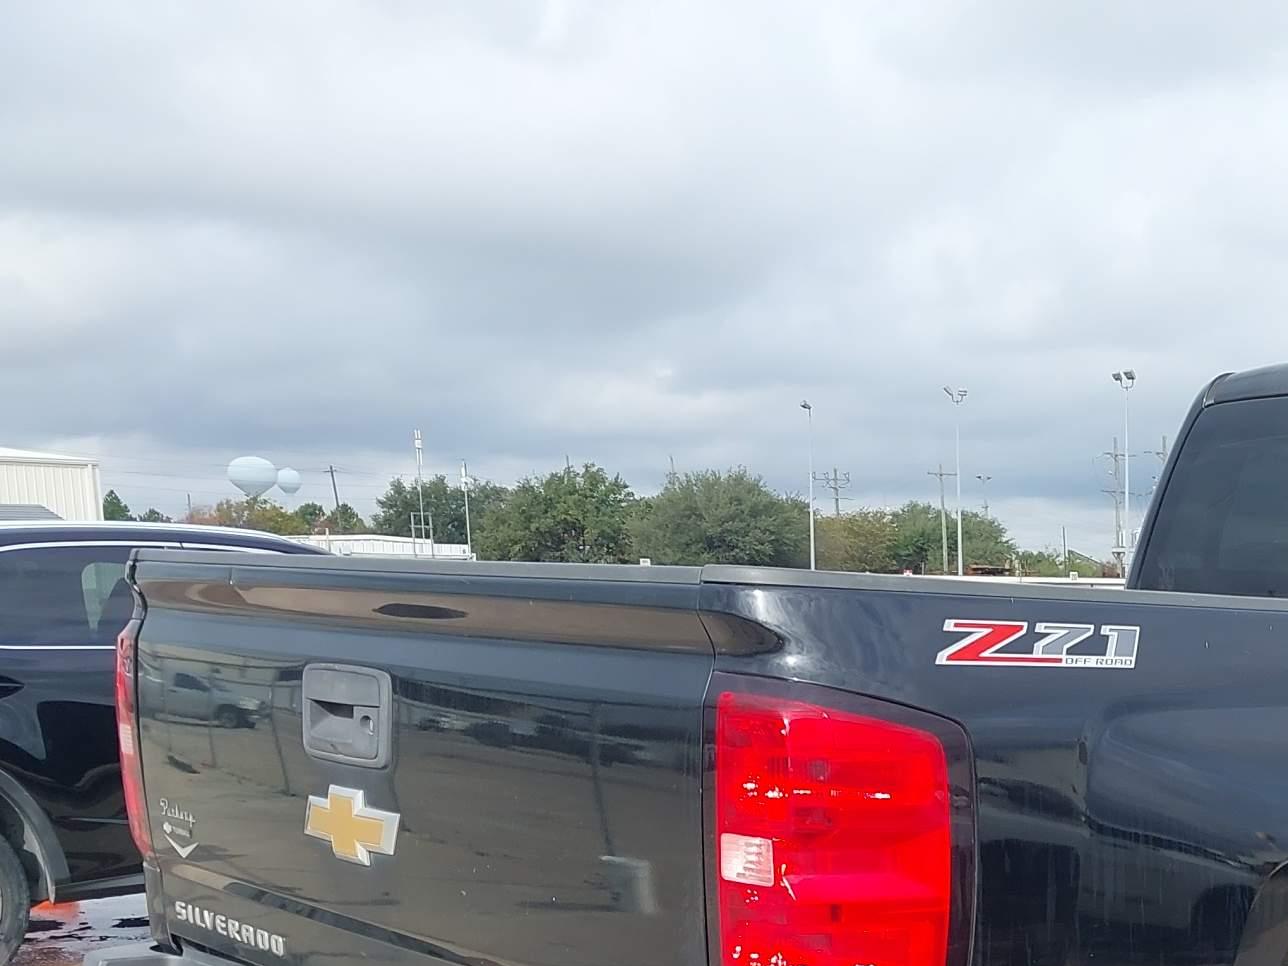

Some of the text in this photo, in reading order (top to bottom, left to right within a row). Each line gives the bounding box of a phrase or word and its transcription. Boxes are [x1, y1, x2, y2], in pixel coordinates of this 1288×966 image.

[935, 618, 1140, 668] Z71
[1065, 657, 1133, 667] OFF ROAD
[174, 900, 285, 957] SILVERADO
